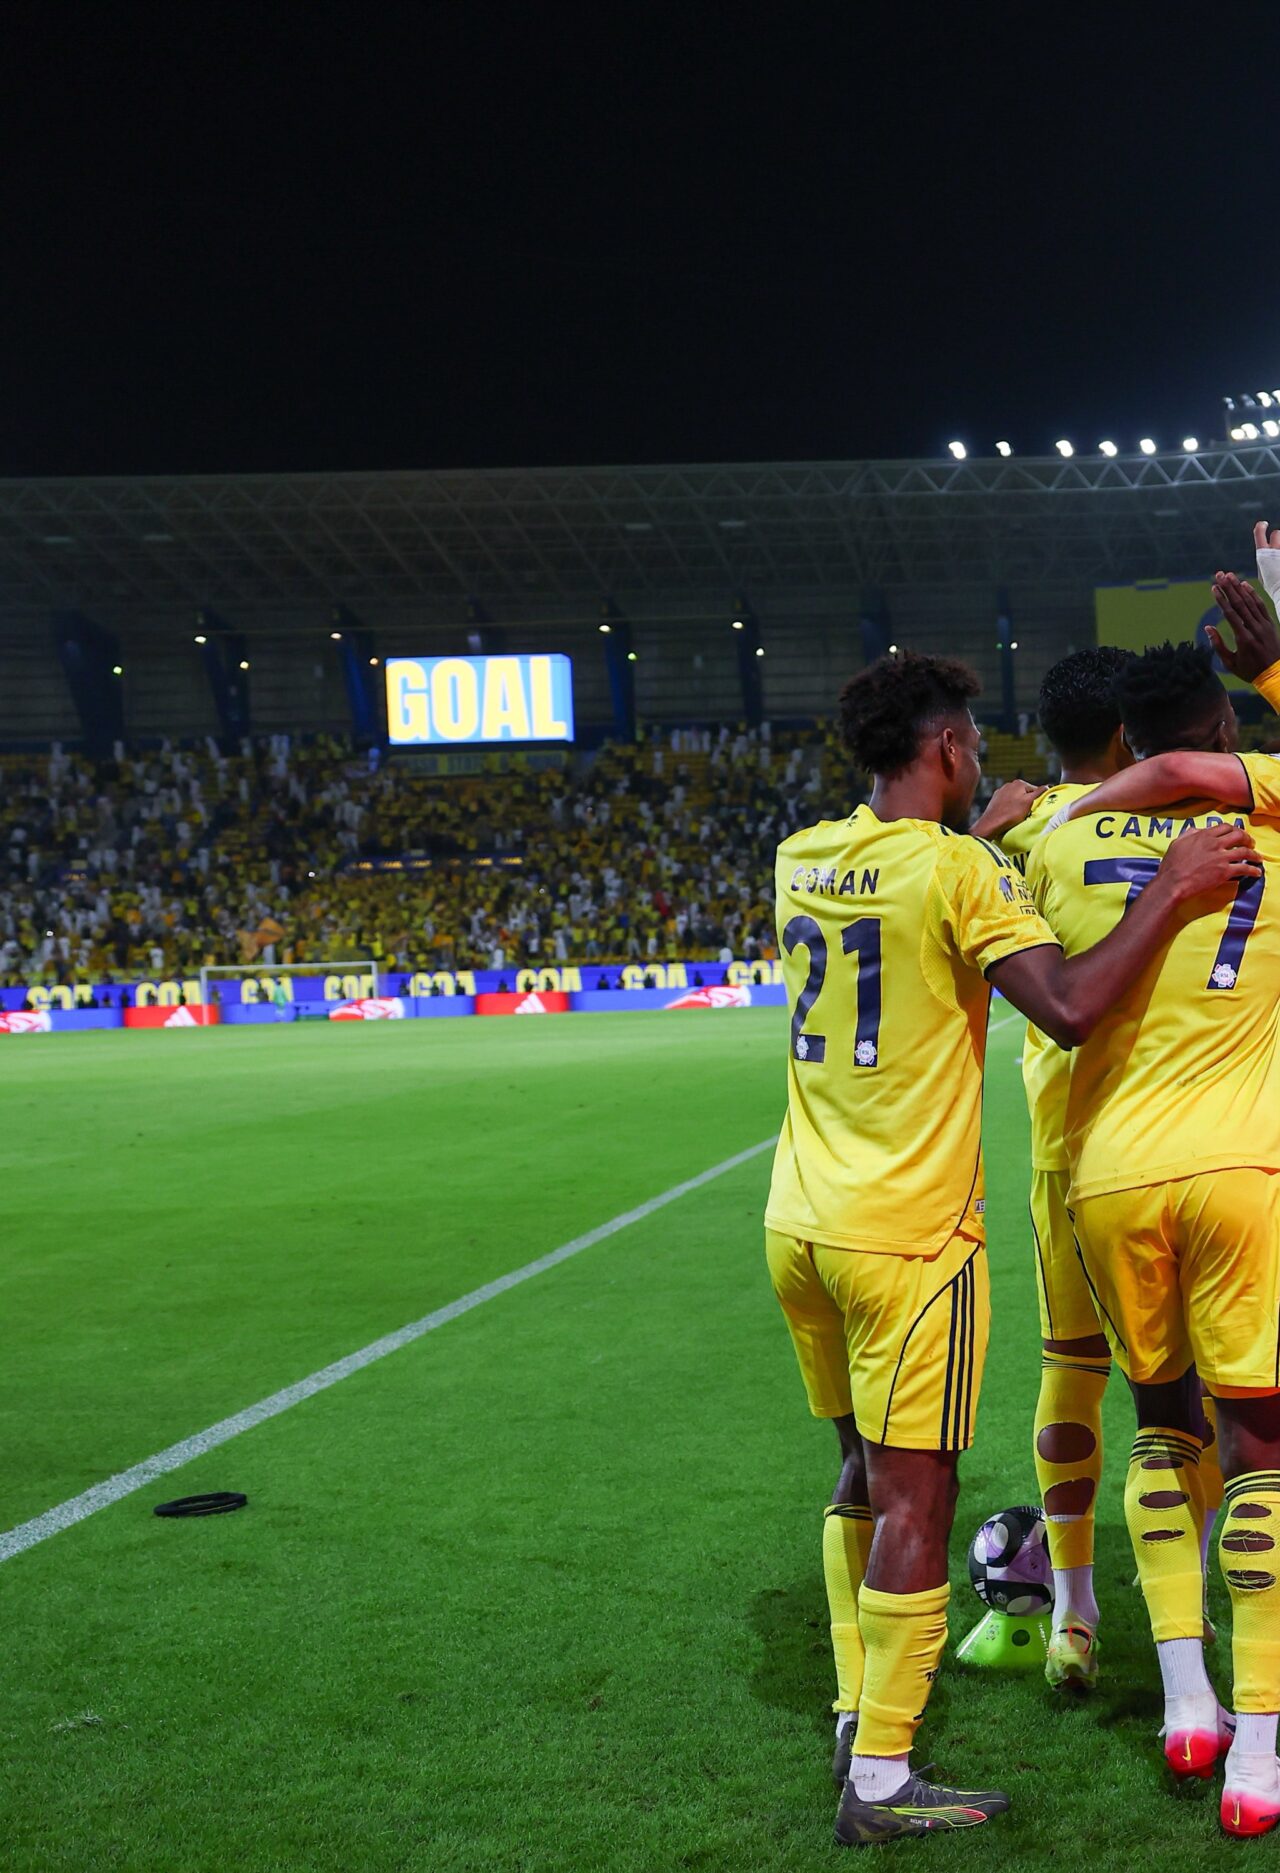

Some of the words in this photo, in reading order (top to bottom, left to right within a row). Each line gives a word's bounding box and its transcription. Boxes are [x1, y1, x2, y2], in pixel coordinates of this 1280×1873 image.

[386, 658, 567, 740] GOAL
[791, 865, 880, 896] COMAN
[782, 915, 882, 1068] 21
